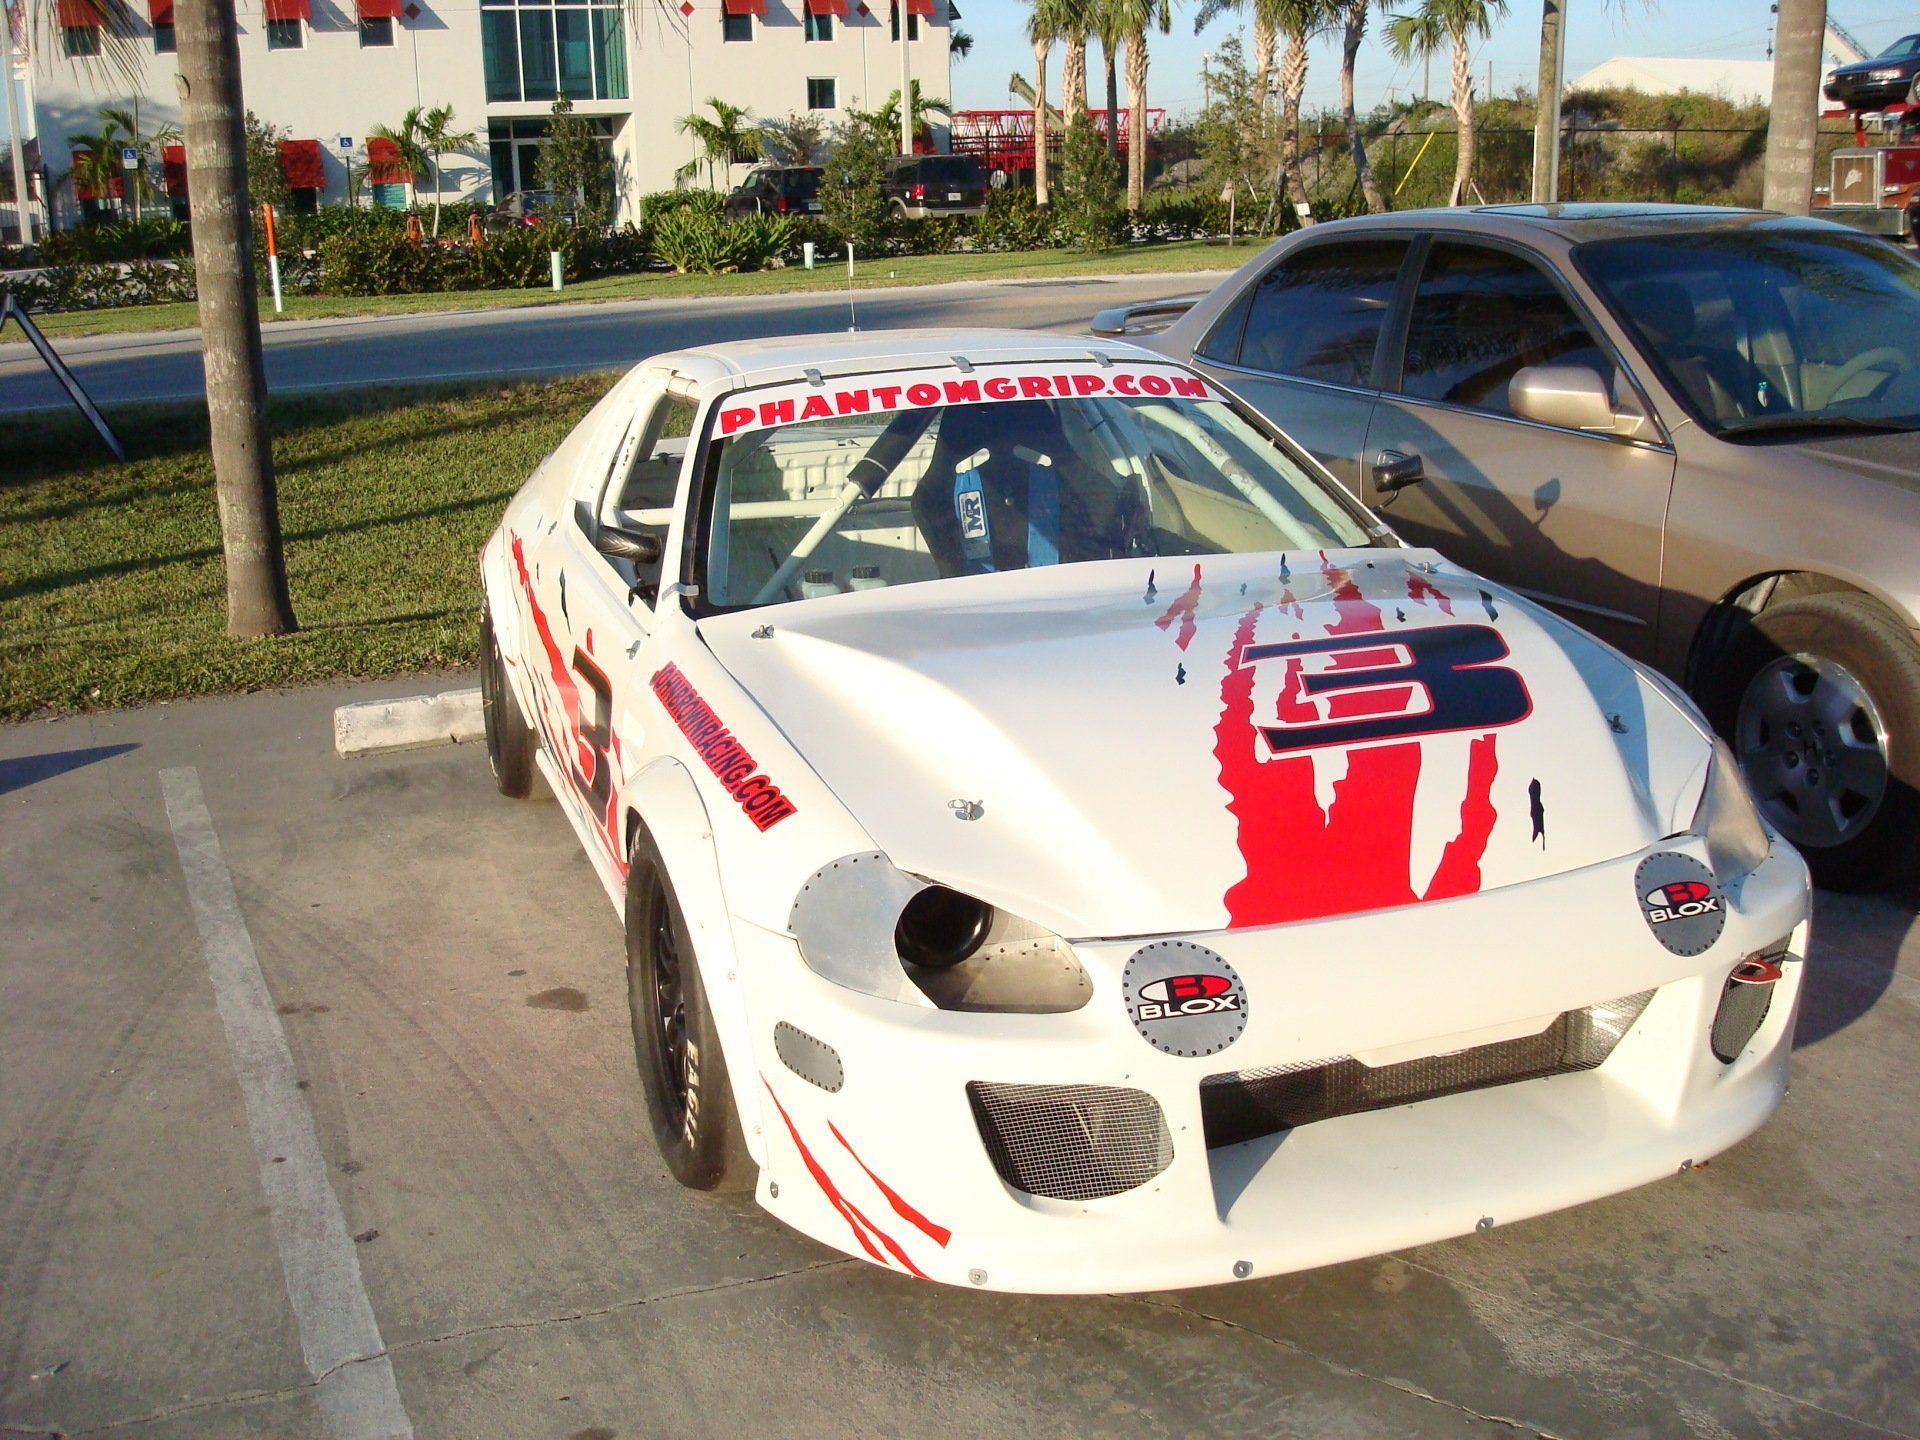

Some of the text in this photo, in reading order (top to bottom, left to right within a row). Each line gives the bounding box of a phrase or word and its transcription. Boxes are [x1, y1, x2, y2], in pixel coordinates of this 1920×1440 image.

[720, 373, 1209, 434] PHANTOMGRIP.COM
[651, 661, 797, 831] JOHNBROWNRACING.COM
[1649, 898, 1719, 923] BLOX
[1140, 996, 1239, 1020] BLOX
